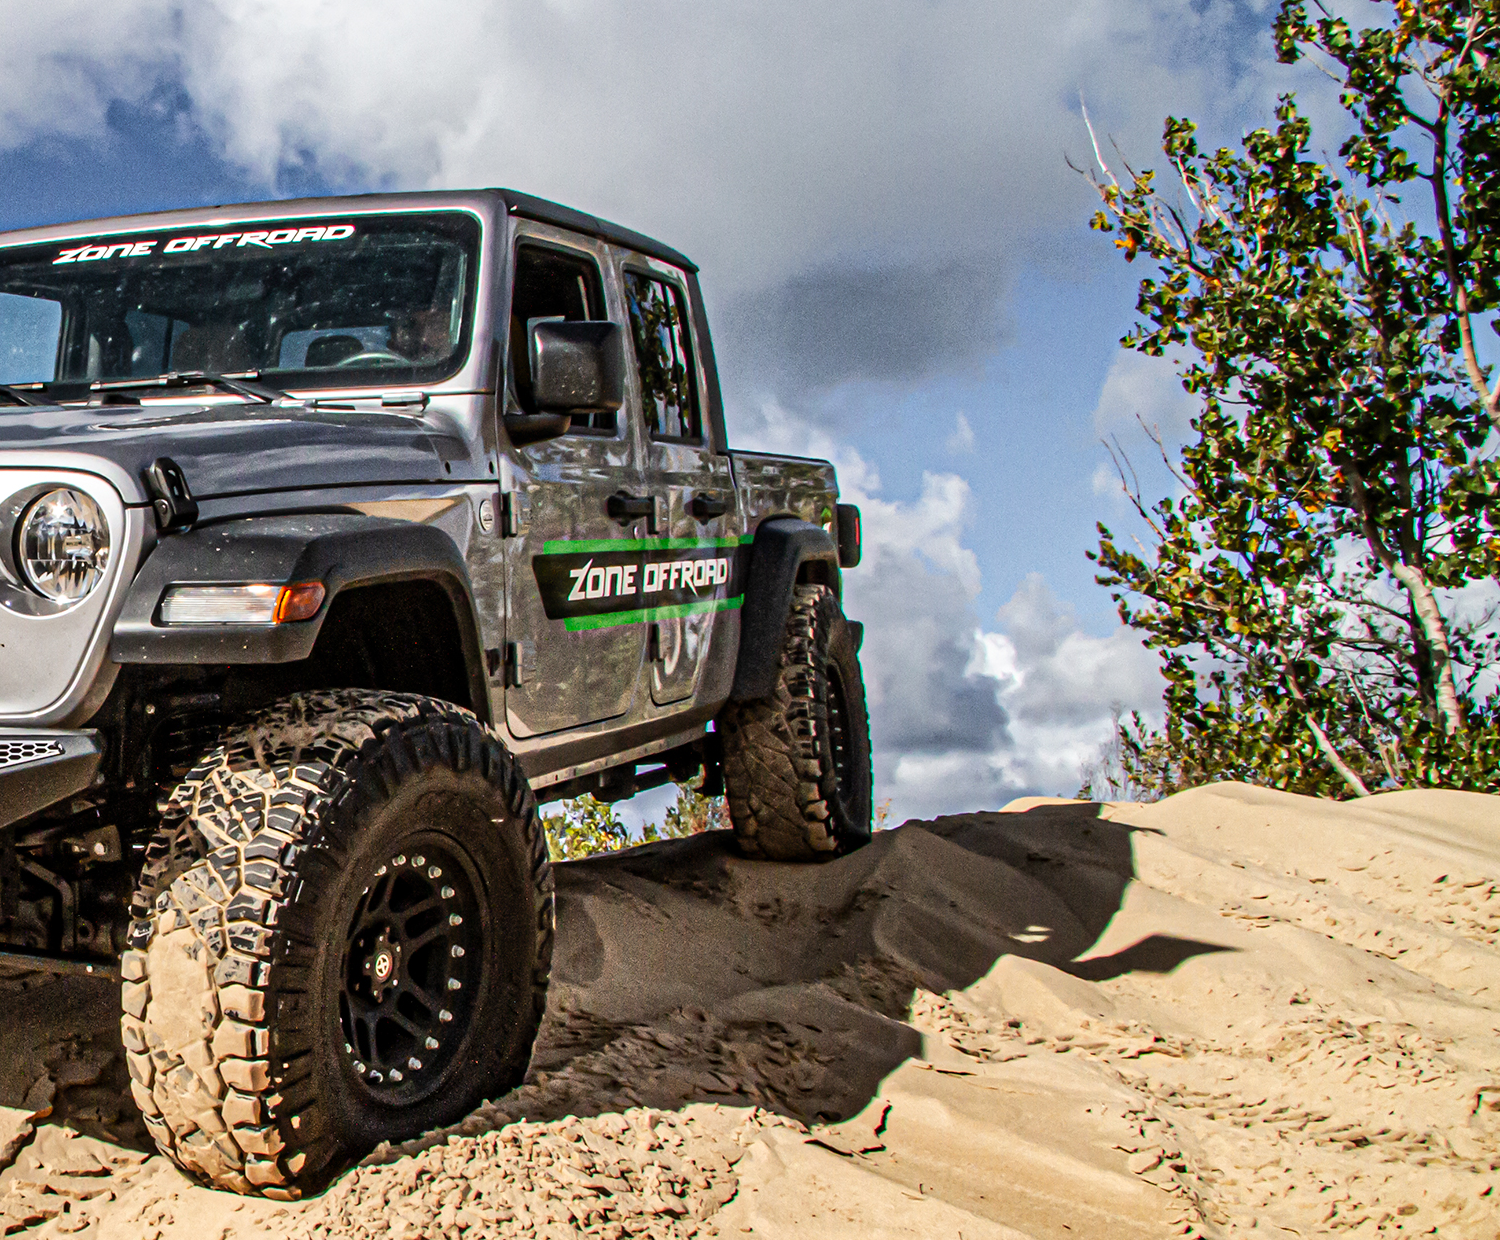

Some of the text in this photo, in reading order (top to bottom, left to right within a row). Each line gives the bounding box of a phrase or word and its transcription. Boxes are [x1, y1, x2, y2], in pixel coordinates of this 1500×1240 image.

[52, 225, 356, 265] ZONE OFFROAD
[568, 558, 728, 601] ZONE OFFROAD
